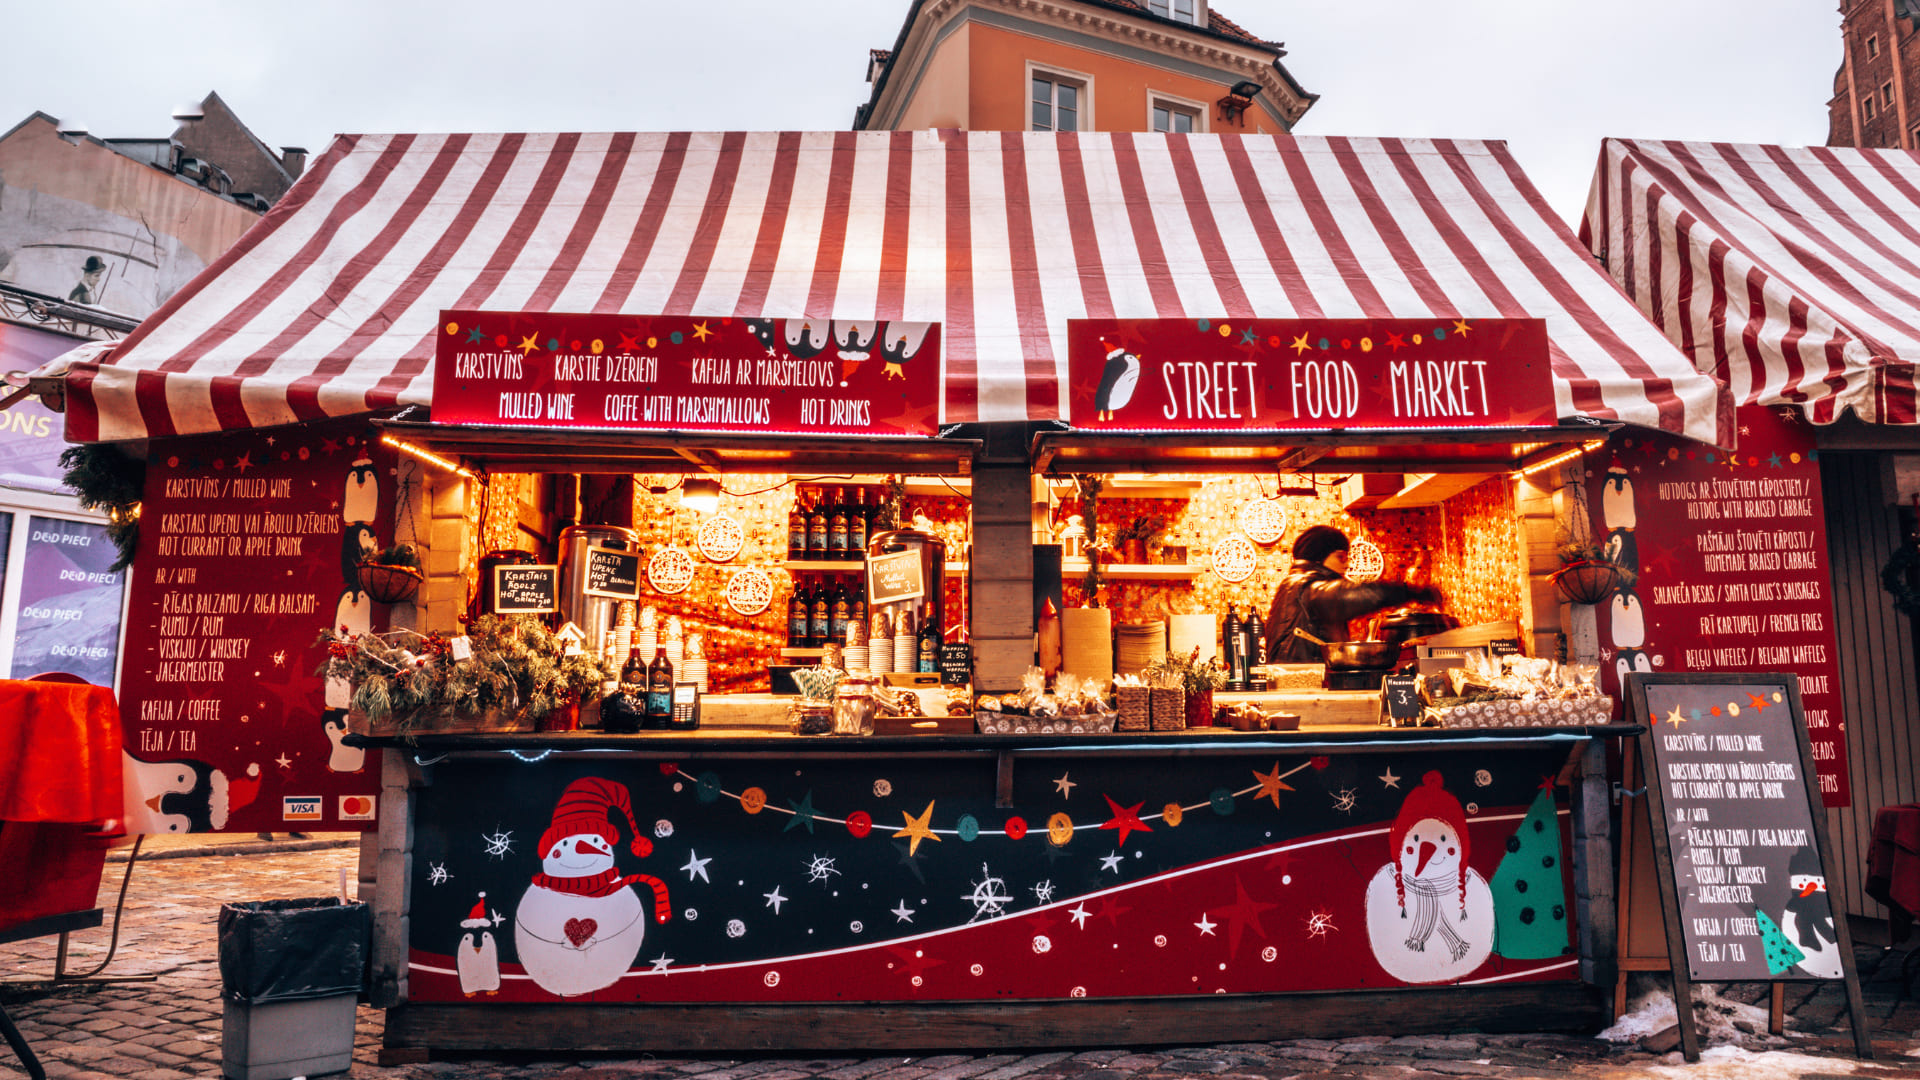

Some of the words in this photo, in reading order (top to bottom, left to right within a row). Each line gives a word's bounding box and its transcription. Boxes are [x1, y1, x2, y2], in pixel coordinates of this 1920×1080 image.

[456, 350, 524, 379] KARSTVĪNS
[555, 354, 602, 382] KARSTIE
[606, 353, 658, 383] DZĒRIENI
[692, 358, 731, 385] KAFIJA
[736, 360, 752, 385] AR
[756, 354, 834, 387] MARŠMELOVS
[1162, 361, 1257, 420] STREET
[1291, 361, 1360, 419] FOOD
[1390, 360, 1489, 418] MARKET
[499, 392, 542, 419] MULLED
[548, 394, 575, 421] WINE
[604, 395, 639, 422] COFFE
[644, 396, 672, 422] WITH
[676, 396, 770, 424] MARSHMALLOWS
[801, 399, 825, 425] HOT
[830, 399, 871, 426] DRINKS
[166, 476, 219, 498] KARSTVĪNS
[234, 479, 267, 498] MULLED
[271, 479, 293, 498] WINE
[1659, 482, 1697, 500] HOTDOGS
[1700, 481, 1711, 499] AR
[1712, 477, 1755, 499] ŠTOVĒTIEM
[1759, 477, 1801, 498] KĀPOSTIEM
[1688, 502, 1720, 520] HOTDOG
[1723, 501, 1743, 519] WITH
[1745, 500, 1776, 518] BRAISED
[1779, 499, 1813, 517] CABBAGE
[161, 514, 206, 534] KARSTAIS
[245, 514, 261, 534] VAI
[264, 512, 293, 534] ĀBOLU
[296, 512, 339, 534] DZĒRIENS
[62, 534, 91, 546] PIECI
[158, 536, 178, 556] HOT
[182, 536, 225, 556] CURRANT
[229, 536, 241, 556] OR
[245, 536, 273, 556] APPLE
[276, 536, 303, 556] DRINK
[1697, 530, 1735, 552] PAŠMĀJU
[1737, 529, 1772, 551] ŠTOVĒTI
[1774, 530, 1807, 550] KĀPOSTI
[1704, 554, 1747, 572] HOMEMADE
[1749, 552, 1780, 571] BRAISED
[1784, 551, 1817, 570] CABBAGE
[88, 573, 116, 584] PIECI
[155, 568, 166, 584] AR
[178, 568, 197, 584] WITH
[591, 572, 608, 581] HOT
[163, 591, 194, 614] RĪGAS
[196, 594, 240, 614] BALZAMU
[254, 594, 276, 614] RIGA
[279, 594, 316, 614] BALSAM
[501, 590, 518, 598] HOT
[1654, 582, 1691, 605] SALAVEČA
[1692, 585, 1715, 603] DESAS
[1725, 584, 1749, 602] SANTA
[1783, 582, 1820, 600] SAUSAGES
[53, 609, 82, 620] PIECI
[1700, 615, 1715, 635] FRĪ
[1770, 614, 1799, 633] FRENCH
[1802, 614, 1823, 632] FRIES
[160, 616, 189, 636] RUMU
[202, 616, 224, 636] RUM
[80, 648, 109, 658] PIECI
[160, 639, 196, 659] VISKIJU
[210, 639, 250, 659] WHISKEY
[1713, 648, 1748, 666] VAFELES
[1758, 647, 1790, 665] BELGIAN
[1792, 645, 1826, 664] WAFFLES
[156, 662, 224, 682] JAGERMEISTER
[141, 700, 173, 721] KAFIJA
[188, 700, 221, 721] COFFEE
[140, 728, 163, 752] TĒJA
[180, 731, 196, 752] TEA
[1664, 733, 1707, 751] KARSTVĪNS
[1716, 736, 1744, 751] MULLED
[1745, 736, 1764, 751] WINE
[1668, 764, 1701, 780] KARSTAIS
[1726, 764, 1740, 780] VAI
[1739, 761, 1763, 780] ĀBOLU
[1762, 761, 1795, 780] DZĒRIENS
[1672, 782, 1688, 799] HOT
[1690, 782, 1724, 799] CURRANT
[1726, 782, 1738, 799] OR
[1739, 782, 1761, 799] APPLE
[1762, 782, 1785, 799] DRINK
[291, 804, 314, 813] VISA
[1677, 808, 1686, 822] AR
[1693, 808, 1709, 822] WITH
[1688, 827, 1713, 846] RĪGAS
[1713, 829, 1749, 846] BALZAMU
[1758, 829, 1778, 846] RIGA
[1778, 829, 1808, 846] BALSAM
[1691, 848, 1714, 865] RUMU
[1724, 848, 1742, 865] RUM
[1694, 867, 1725, 884] VISKIJU
[1735, 867, 1767, 884] WHISKEY
[1698, 886, 1754, 903] JAGERMEISTER
[1693, 918, 1721, 936] KAFIJA
[1731, 918, 1759, 936] COFFEE
[1698, 941, 1720, 962] TĒJA
[1729, 944, 1746, 962] TEA
